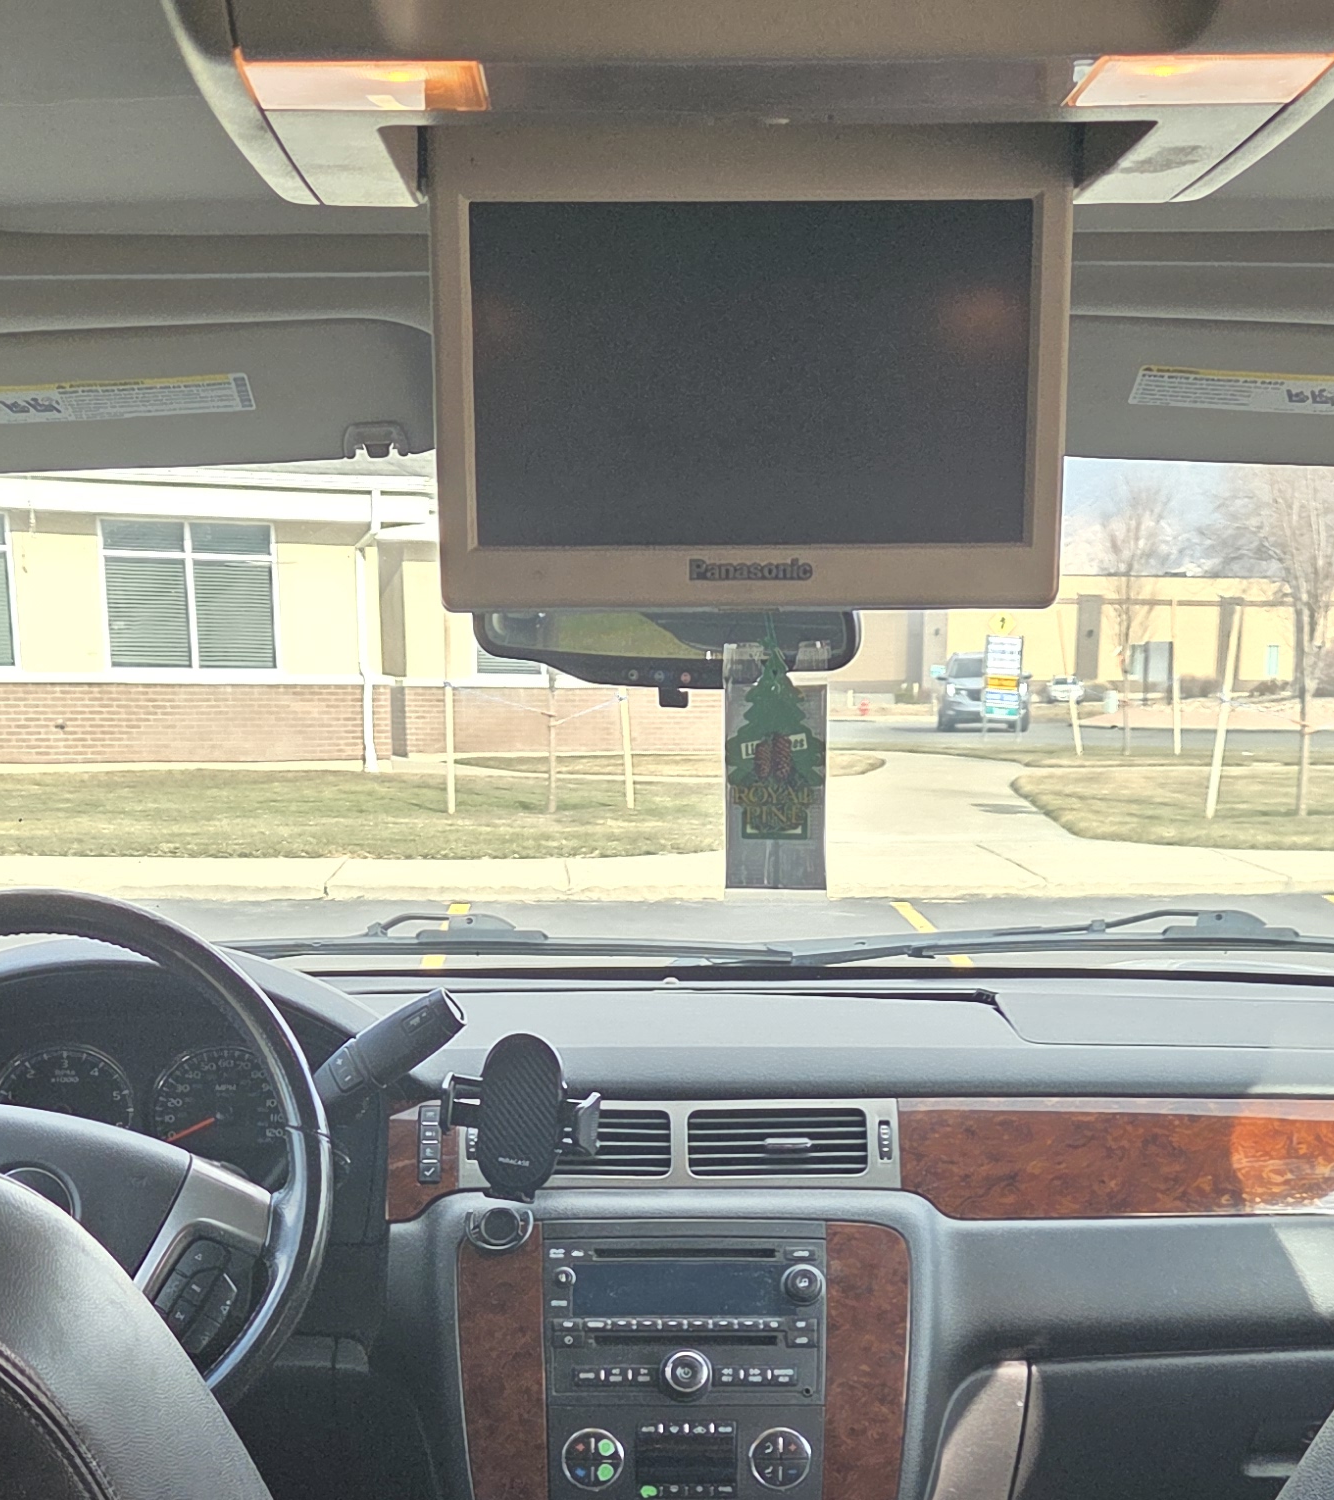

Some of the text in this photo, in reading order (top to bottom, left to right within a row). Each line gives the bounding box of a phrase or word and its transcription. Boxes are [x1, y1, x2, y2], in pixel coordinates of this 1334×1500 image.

[689, 558, 813, 581] Panasonic
[733, 784, 812, 804] ROYAL
[747, 806, 804, 824] PINE
[62, 1060, 69, 1069] 3
[27, 1070, 36, 1079] 2
[90, 1068, 99, 1076] 4
[175, 1084, 190, 1093] 30
[112, 1090, 121, 1100] 5
[167, 1098, 183, 1107] 20
